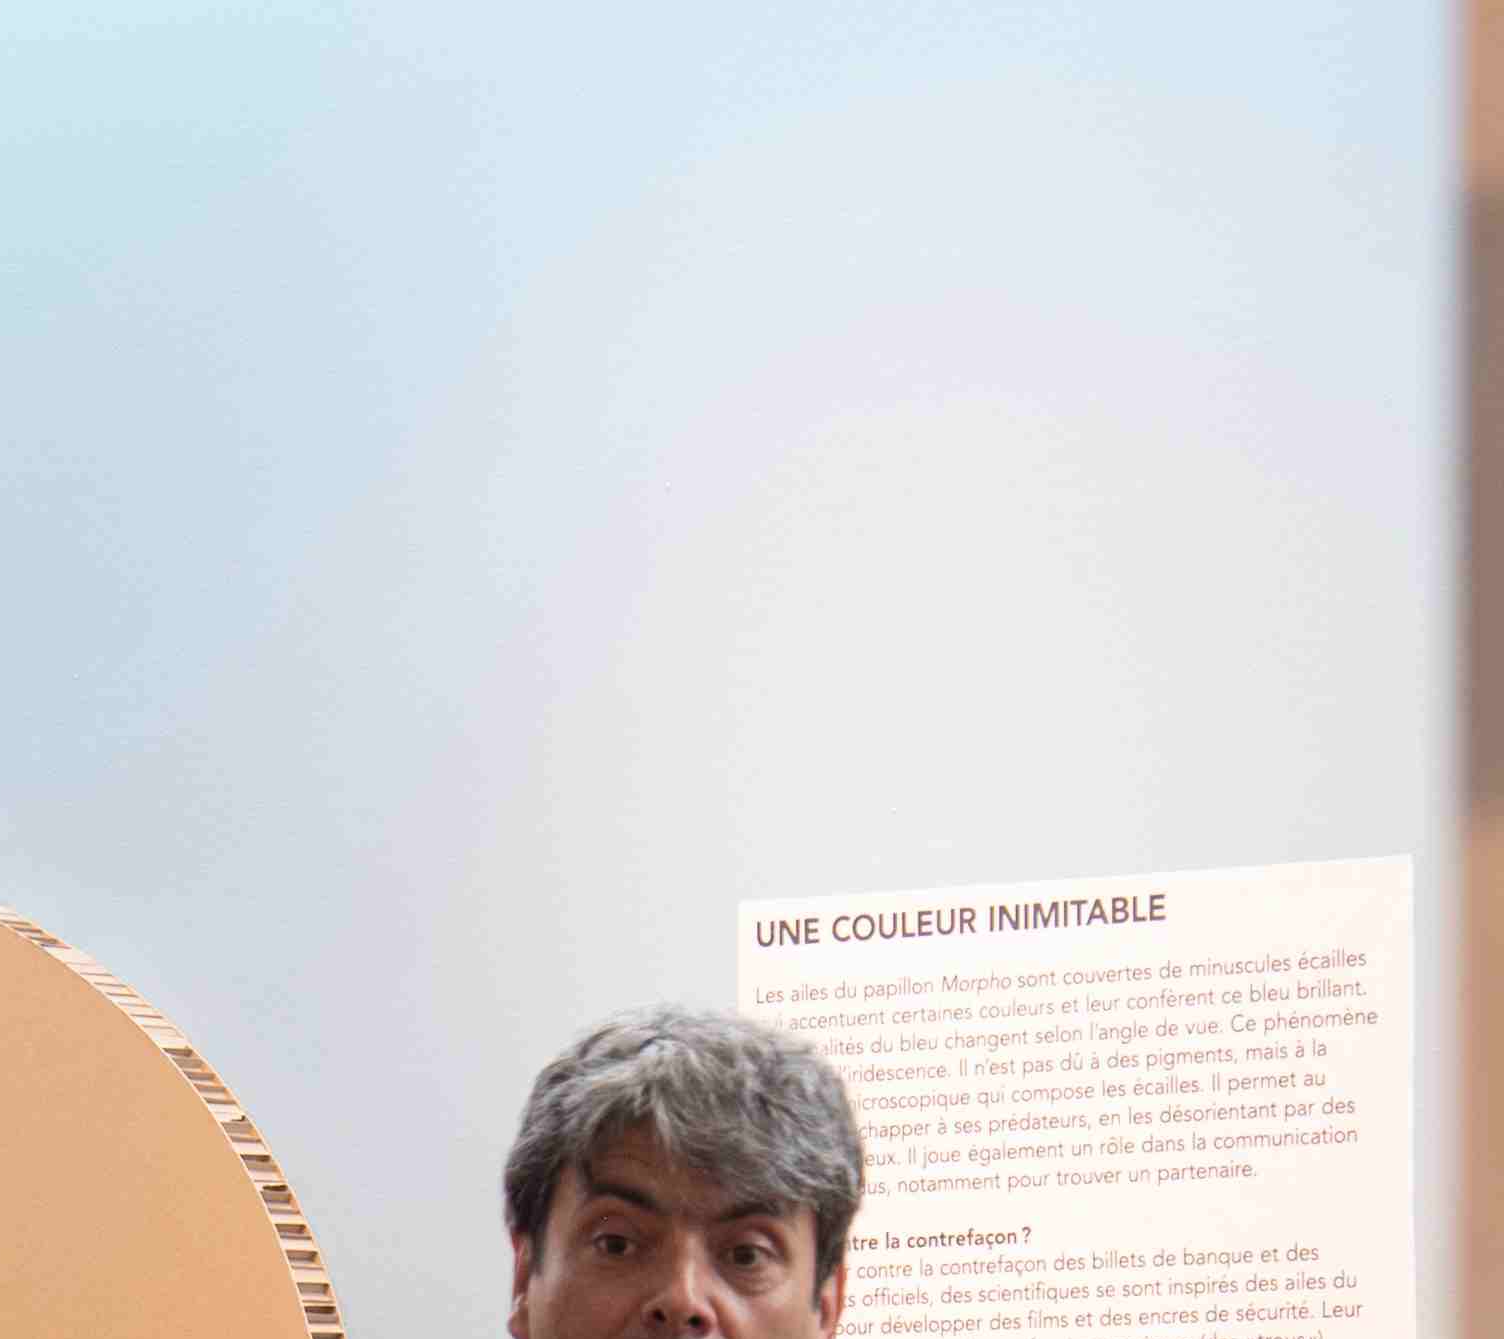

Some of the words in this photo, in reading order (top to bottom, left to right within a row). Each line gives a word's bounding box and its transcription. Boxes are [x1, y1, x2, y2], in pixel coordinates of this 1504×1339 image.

[756, 917, 821, 948] UNE
[831, 906, 977, 943] COULEUR
[988, 893, 1167, 933] INIMITABLE
[755, 986, 785, 1006] Les
[789, 983, 829, 1003] ailes
[833, 979, 858, 1001] du
[863, 975, 934, 1003] papillon
[941, 970, 1013, 997] Morpho
[1016, 970, 1057, 989] sont
[1062, 965, 1153, 987] couvertes
[1158, 959, 1184, 981] de
[1188, 952, 1293, 977] minuscules
[1297, 948, 1368, 971] écailles
[787, 1011, 886, 1032] accentuent
[891, 1006, 974, 1025] certaines
[978, 998, 1056, 1020] couleurs
[1085, 993, 1121, 1013] leur
[1125, 988, 1216, 1011] confèrent
[1249, 982, 1291, 1004] bleu
[899, 1032, 939, 1053] bleu
[943, 1029, 1029, 1053] changent
[1033, 1024, 1083, 1045] selon
[1229, 1012, 1258, 1034] Ce
[1263, 1007, 1379, 1037] phénomène
[1106, 1049, 1141, 1070] des
[1245, 1040, 1289, 1062] mais
[1010, 1085, 1096, 1105] compose
[1227, 1071, 1297, 1097] permet
[1159, 1101, 1278, 1125] désorientant
[921, 1145, 962, 1170] joue
[967, 1140, 1065, 1167] également
[1098, 1135, 1136, 1156] rôle
[1140, 1133, 1186, 1154] dans
[1212, 1124, 1359, 1151] communication
[896, 1172, 1001, 1194] notamment
[1007, 1172, 1051, 1194] pour
[1055, 1169, 1123, 1187] trouver
[905, 1226, 1019, 1251] contrefaçon
[855, 1263, 913, 1280] contre
[939, 1253, 1048, 1278] contrefaçon
[1052, 1251, 1087, 1273] des
[1091, 1249, 1147, 1271] billets
[1182, 1247, 1255, 1270] banque
[939, 1284, 974, 1305] des
[977, 1280, 1091, 1305] scientifiques
[1121, 1279, 1163, 1299] sont
[1167, 1273, 1240, 1300] inspirés
[1283, 1270, 1328, 1292] ailes
[879, 1313, 984, 1338] développer
[1026, 1309, 1070, 1329] films
[1098, 1307, 1133, 1328] des
[1137, 1309, 1200, 1327] encres
[1321, 1299, 1365, 1320] Leur
